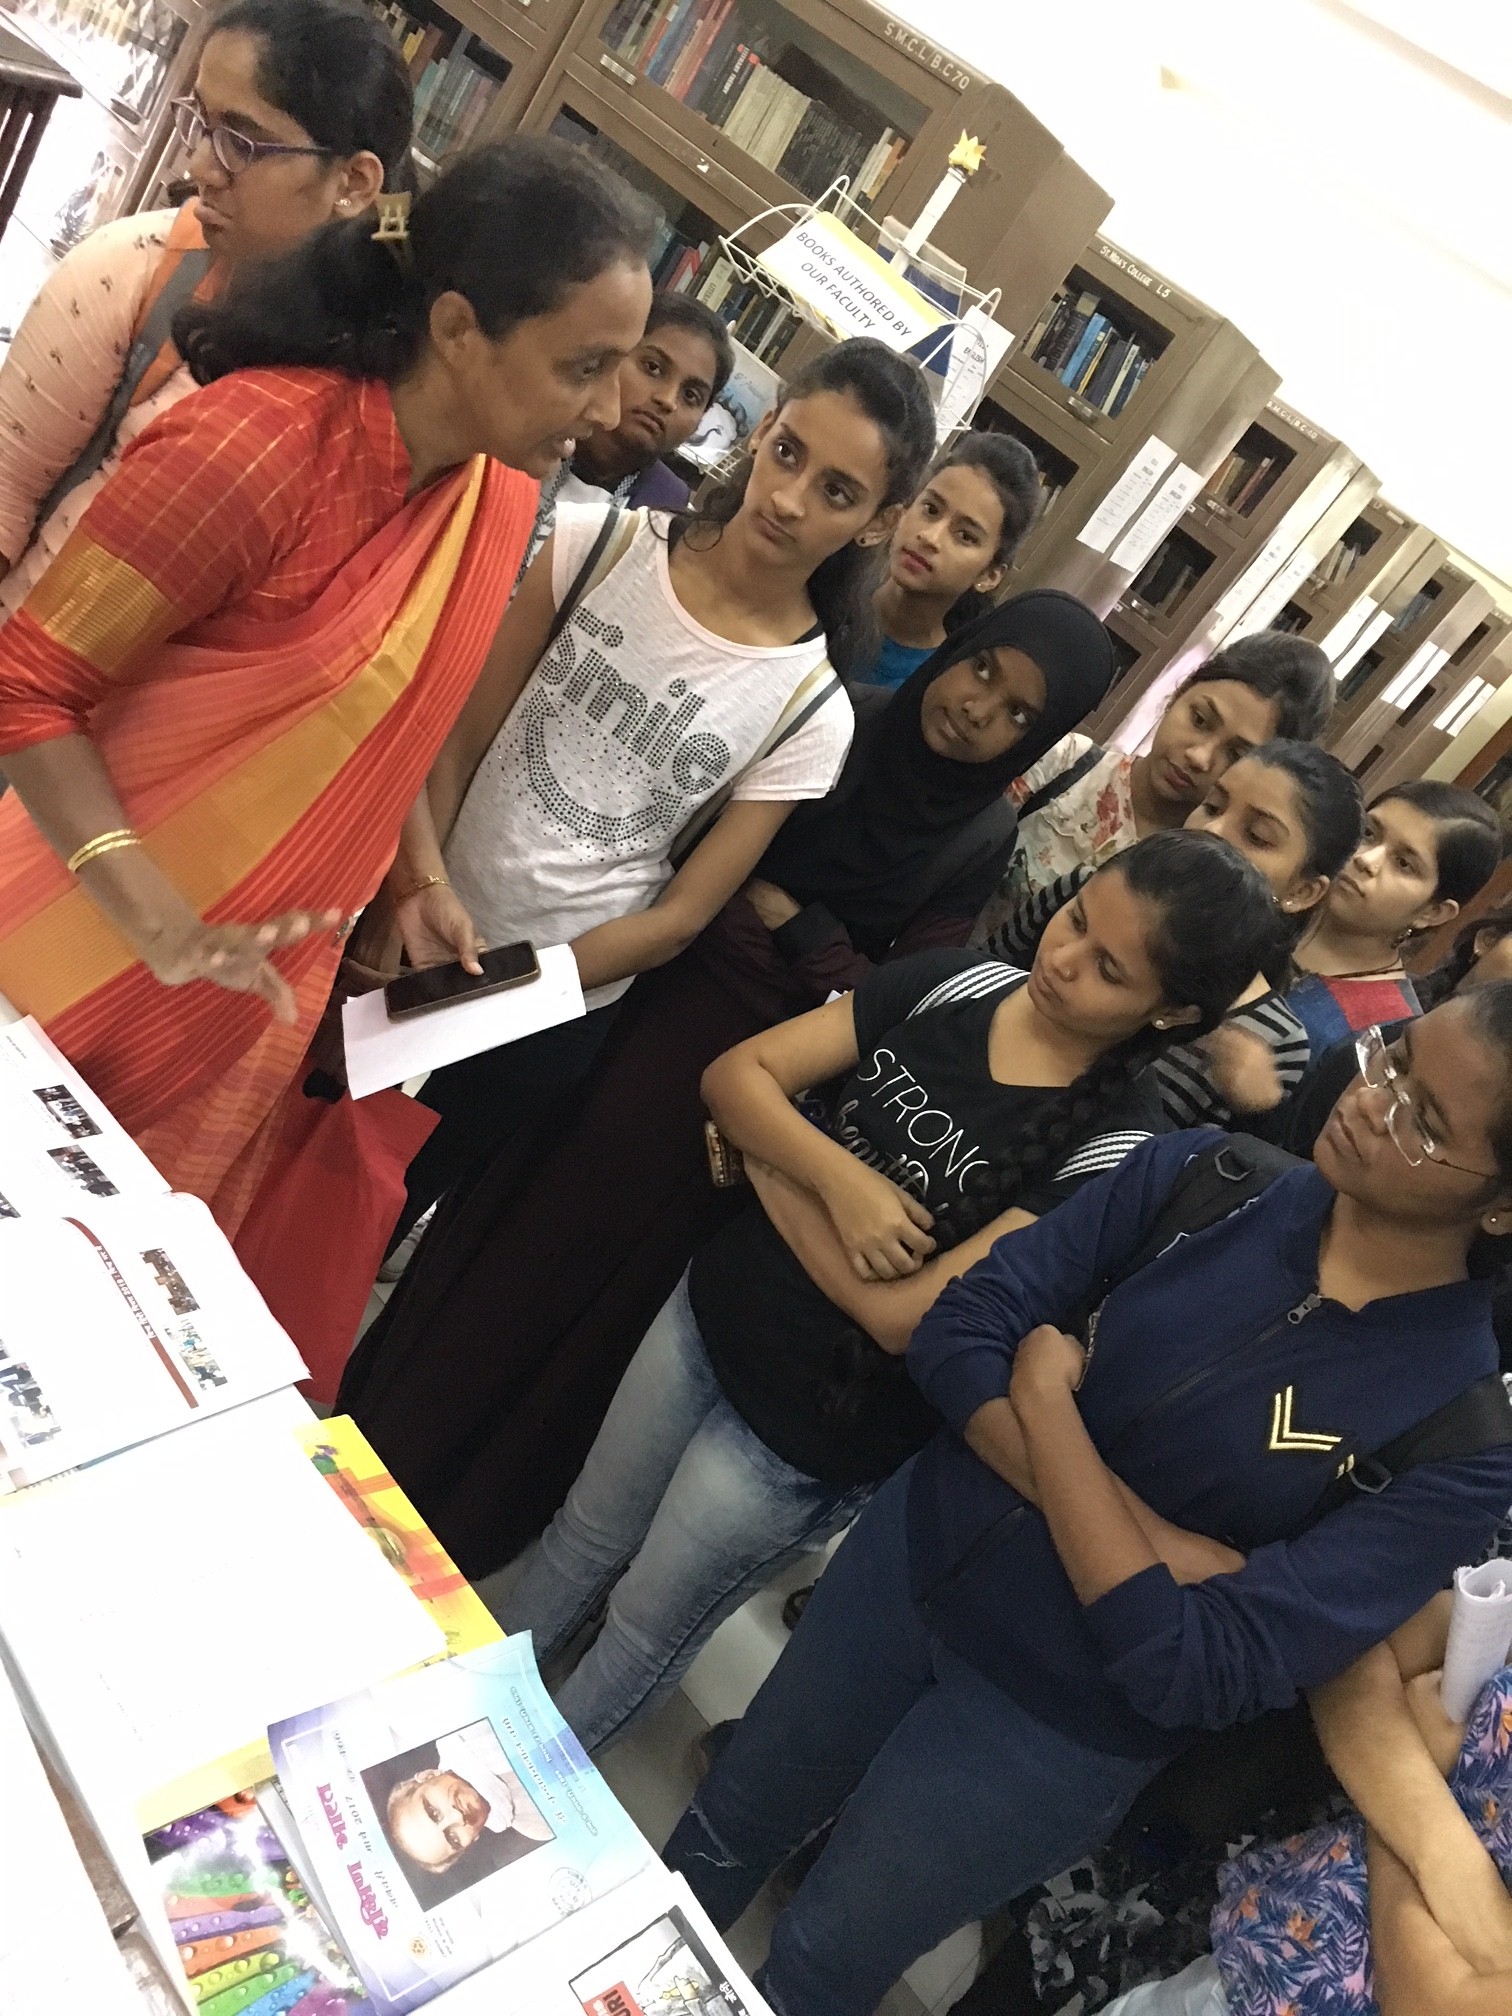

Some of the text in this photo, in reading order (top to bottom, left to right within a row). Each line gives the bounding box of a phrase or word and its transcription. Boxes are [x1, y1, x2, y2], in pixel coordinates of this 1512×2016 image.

[796, 231, 912, 337] BOOKS AUTHORED BY
[801, 262, 876, 329] OUR FACULTY
[316, 1782, 348, 1850] भारत
[345, 1796, 363, 1825] 2017
[347, 1860, 389, 1940] दक्षिण
